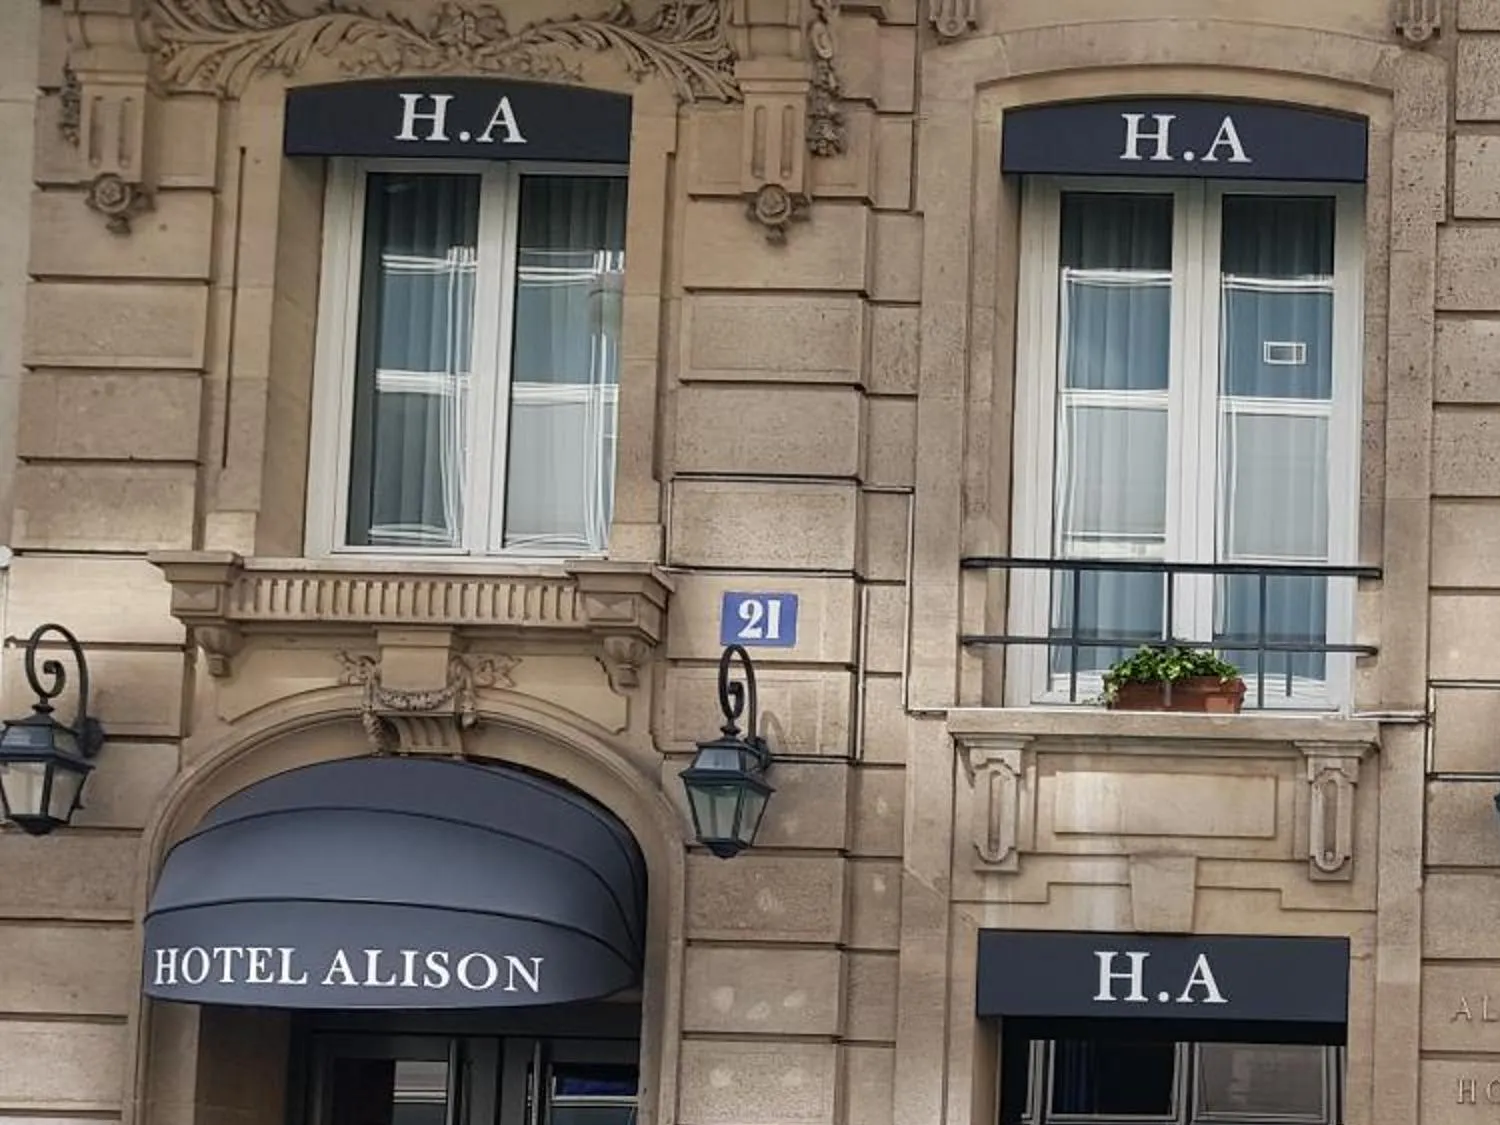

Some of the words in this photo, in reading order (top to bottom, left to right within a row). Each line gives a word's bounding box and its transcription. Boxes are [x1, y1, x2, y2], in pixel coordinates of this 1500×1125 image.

[396, 93, 527, 143] H.A
[1119, 113, 1251, 162] H.A
[737, 599, 781, 639] 21
[154, 947, 308, 985] HOTEL
[321, 949, 544, 993] ALISON
[1093, 951, 1228, 1003] H.A
